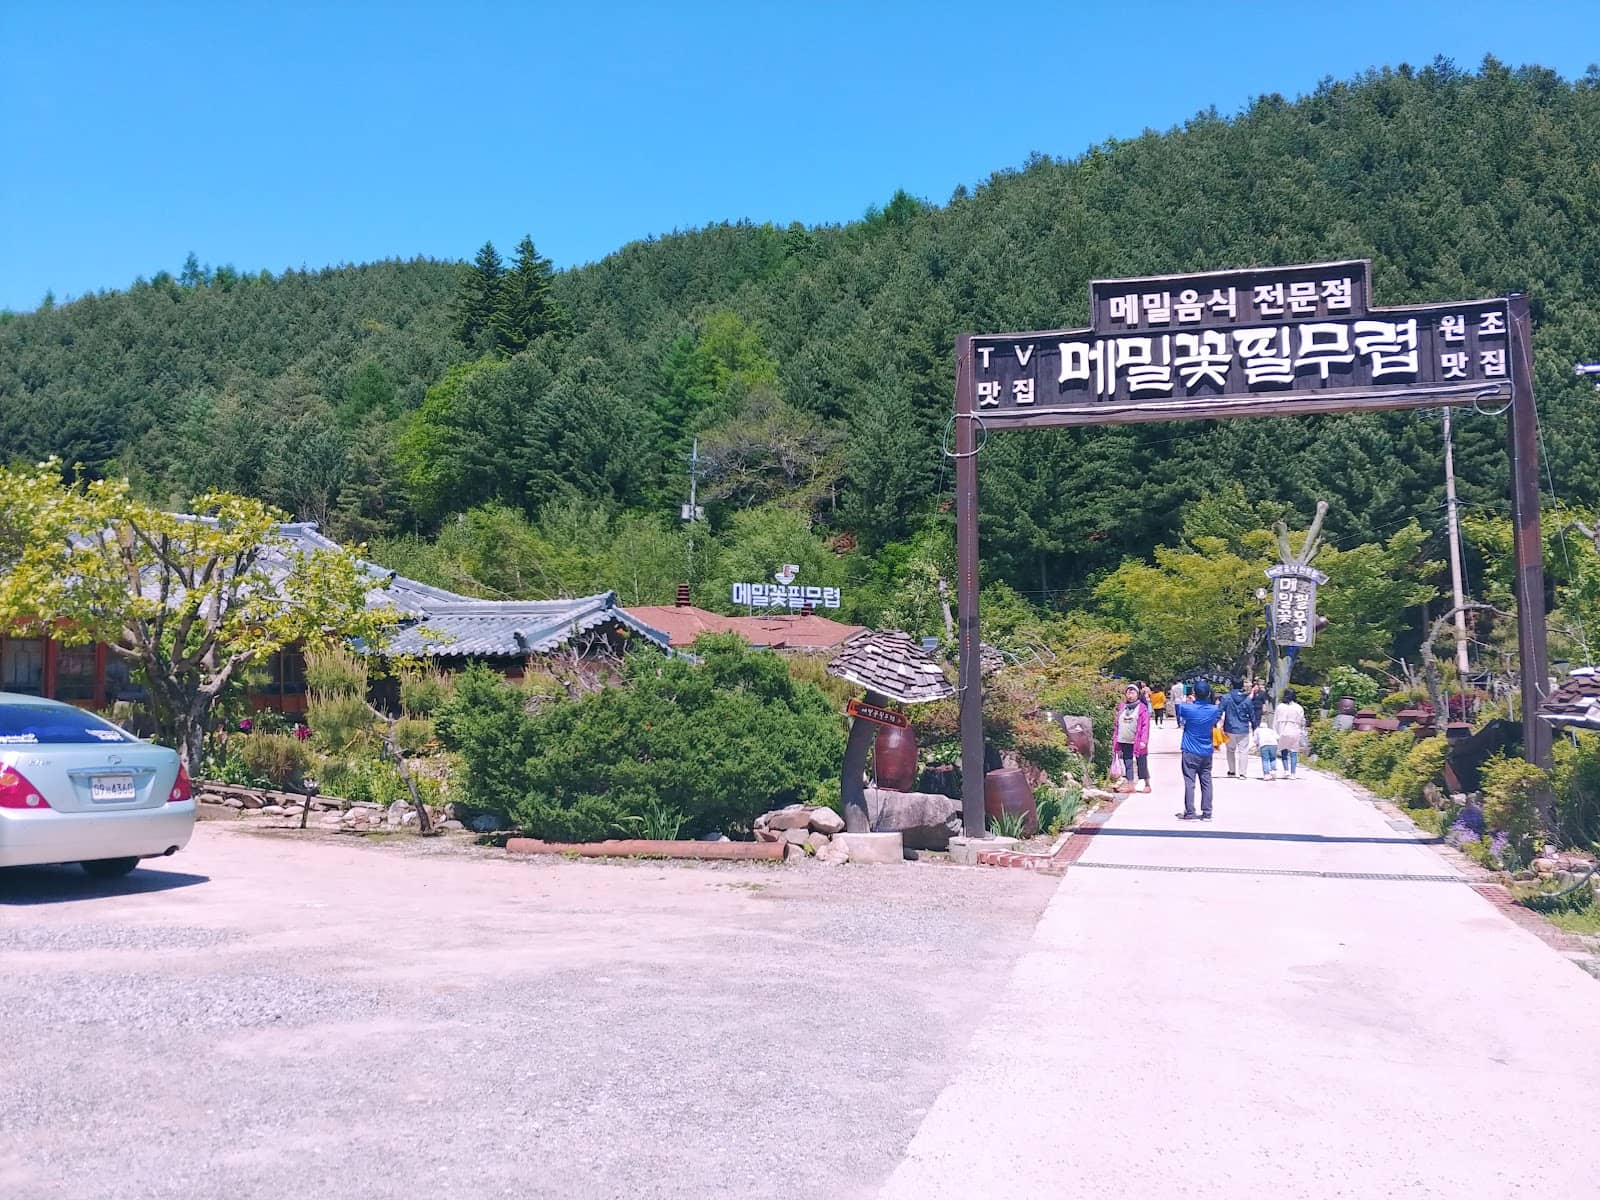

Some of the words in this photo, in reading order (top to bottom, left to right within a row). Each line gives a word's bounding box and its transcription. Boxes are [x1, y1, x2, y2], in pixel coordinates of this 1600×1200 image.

[1109, 286, 1237, 325] 메밀음식
[1253, 278, 1352, 316] 전문점
[1057, 318, 1419, 395] 메밀꽃필무렵
[732, 582, 841, 609] 메밀꽃필무렵
